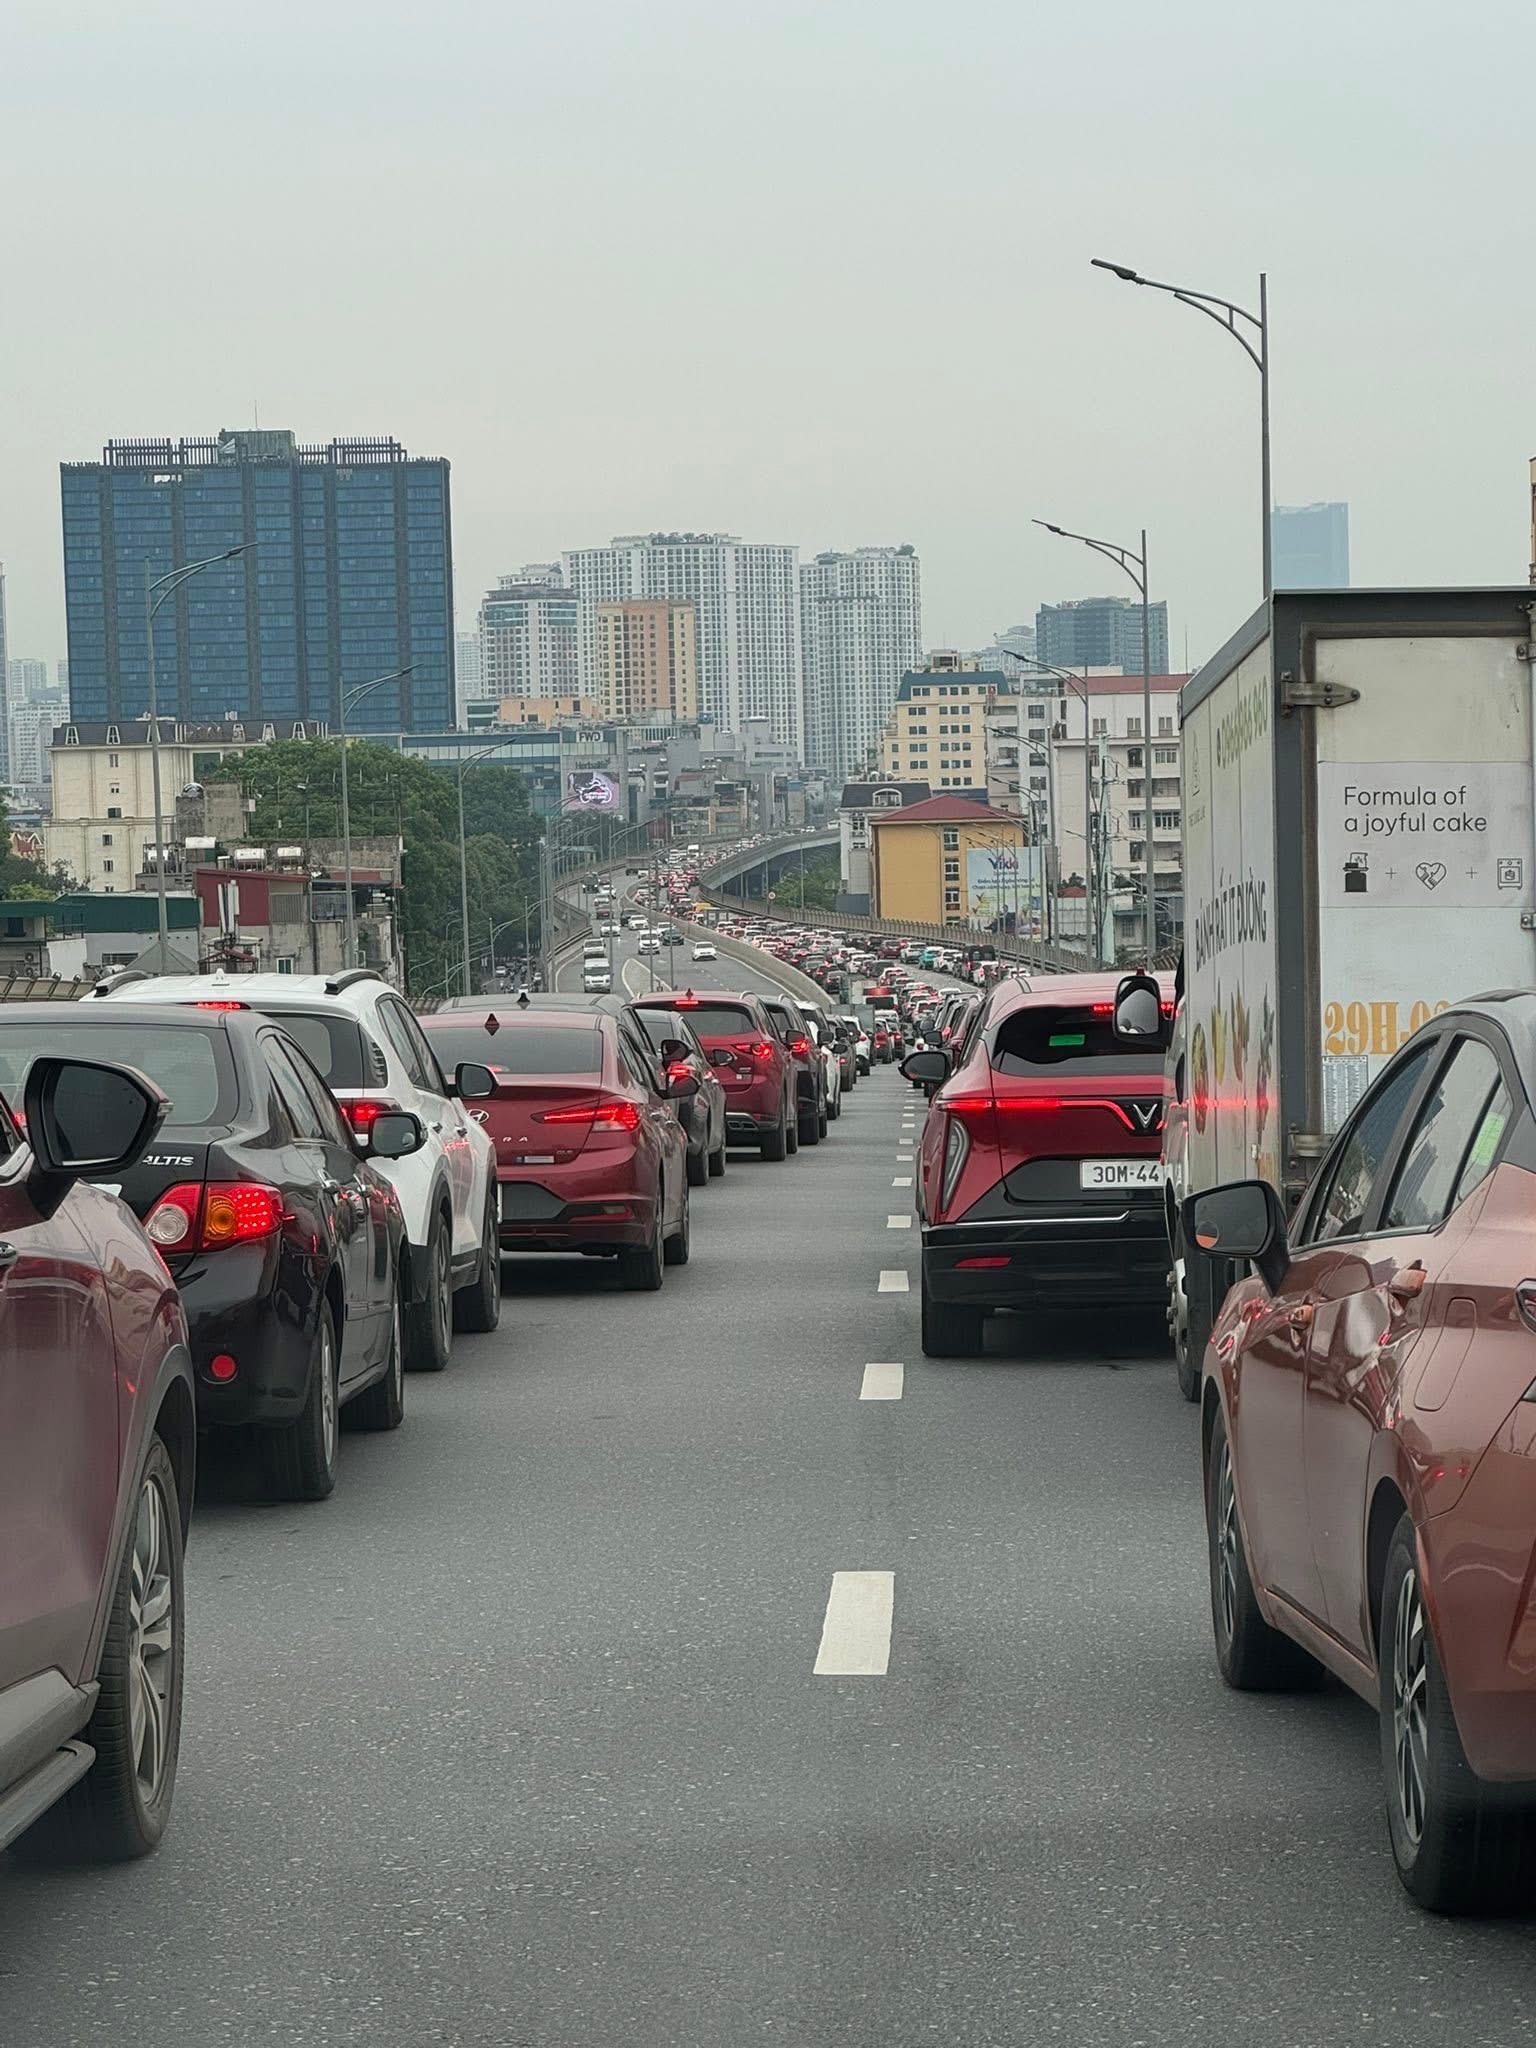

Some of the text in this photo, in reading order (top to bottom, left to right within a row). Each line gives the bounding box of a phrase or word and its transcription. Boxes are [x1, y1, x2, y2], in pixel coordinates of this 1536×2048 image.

[579, 732, 601, 742] FWD
[1344, 785, 1467, 806] Formula of
[1344, 812, 1488, 837] a joyful cake
[142, 1155, 195, 1166] ALTIS
[1093, 1165, 1159, 1183] 30M-44
